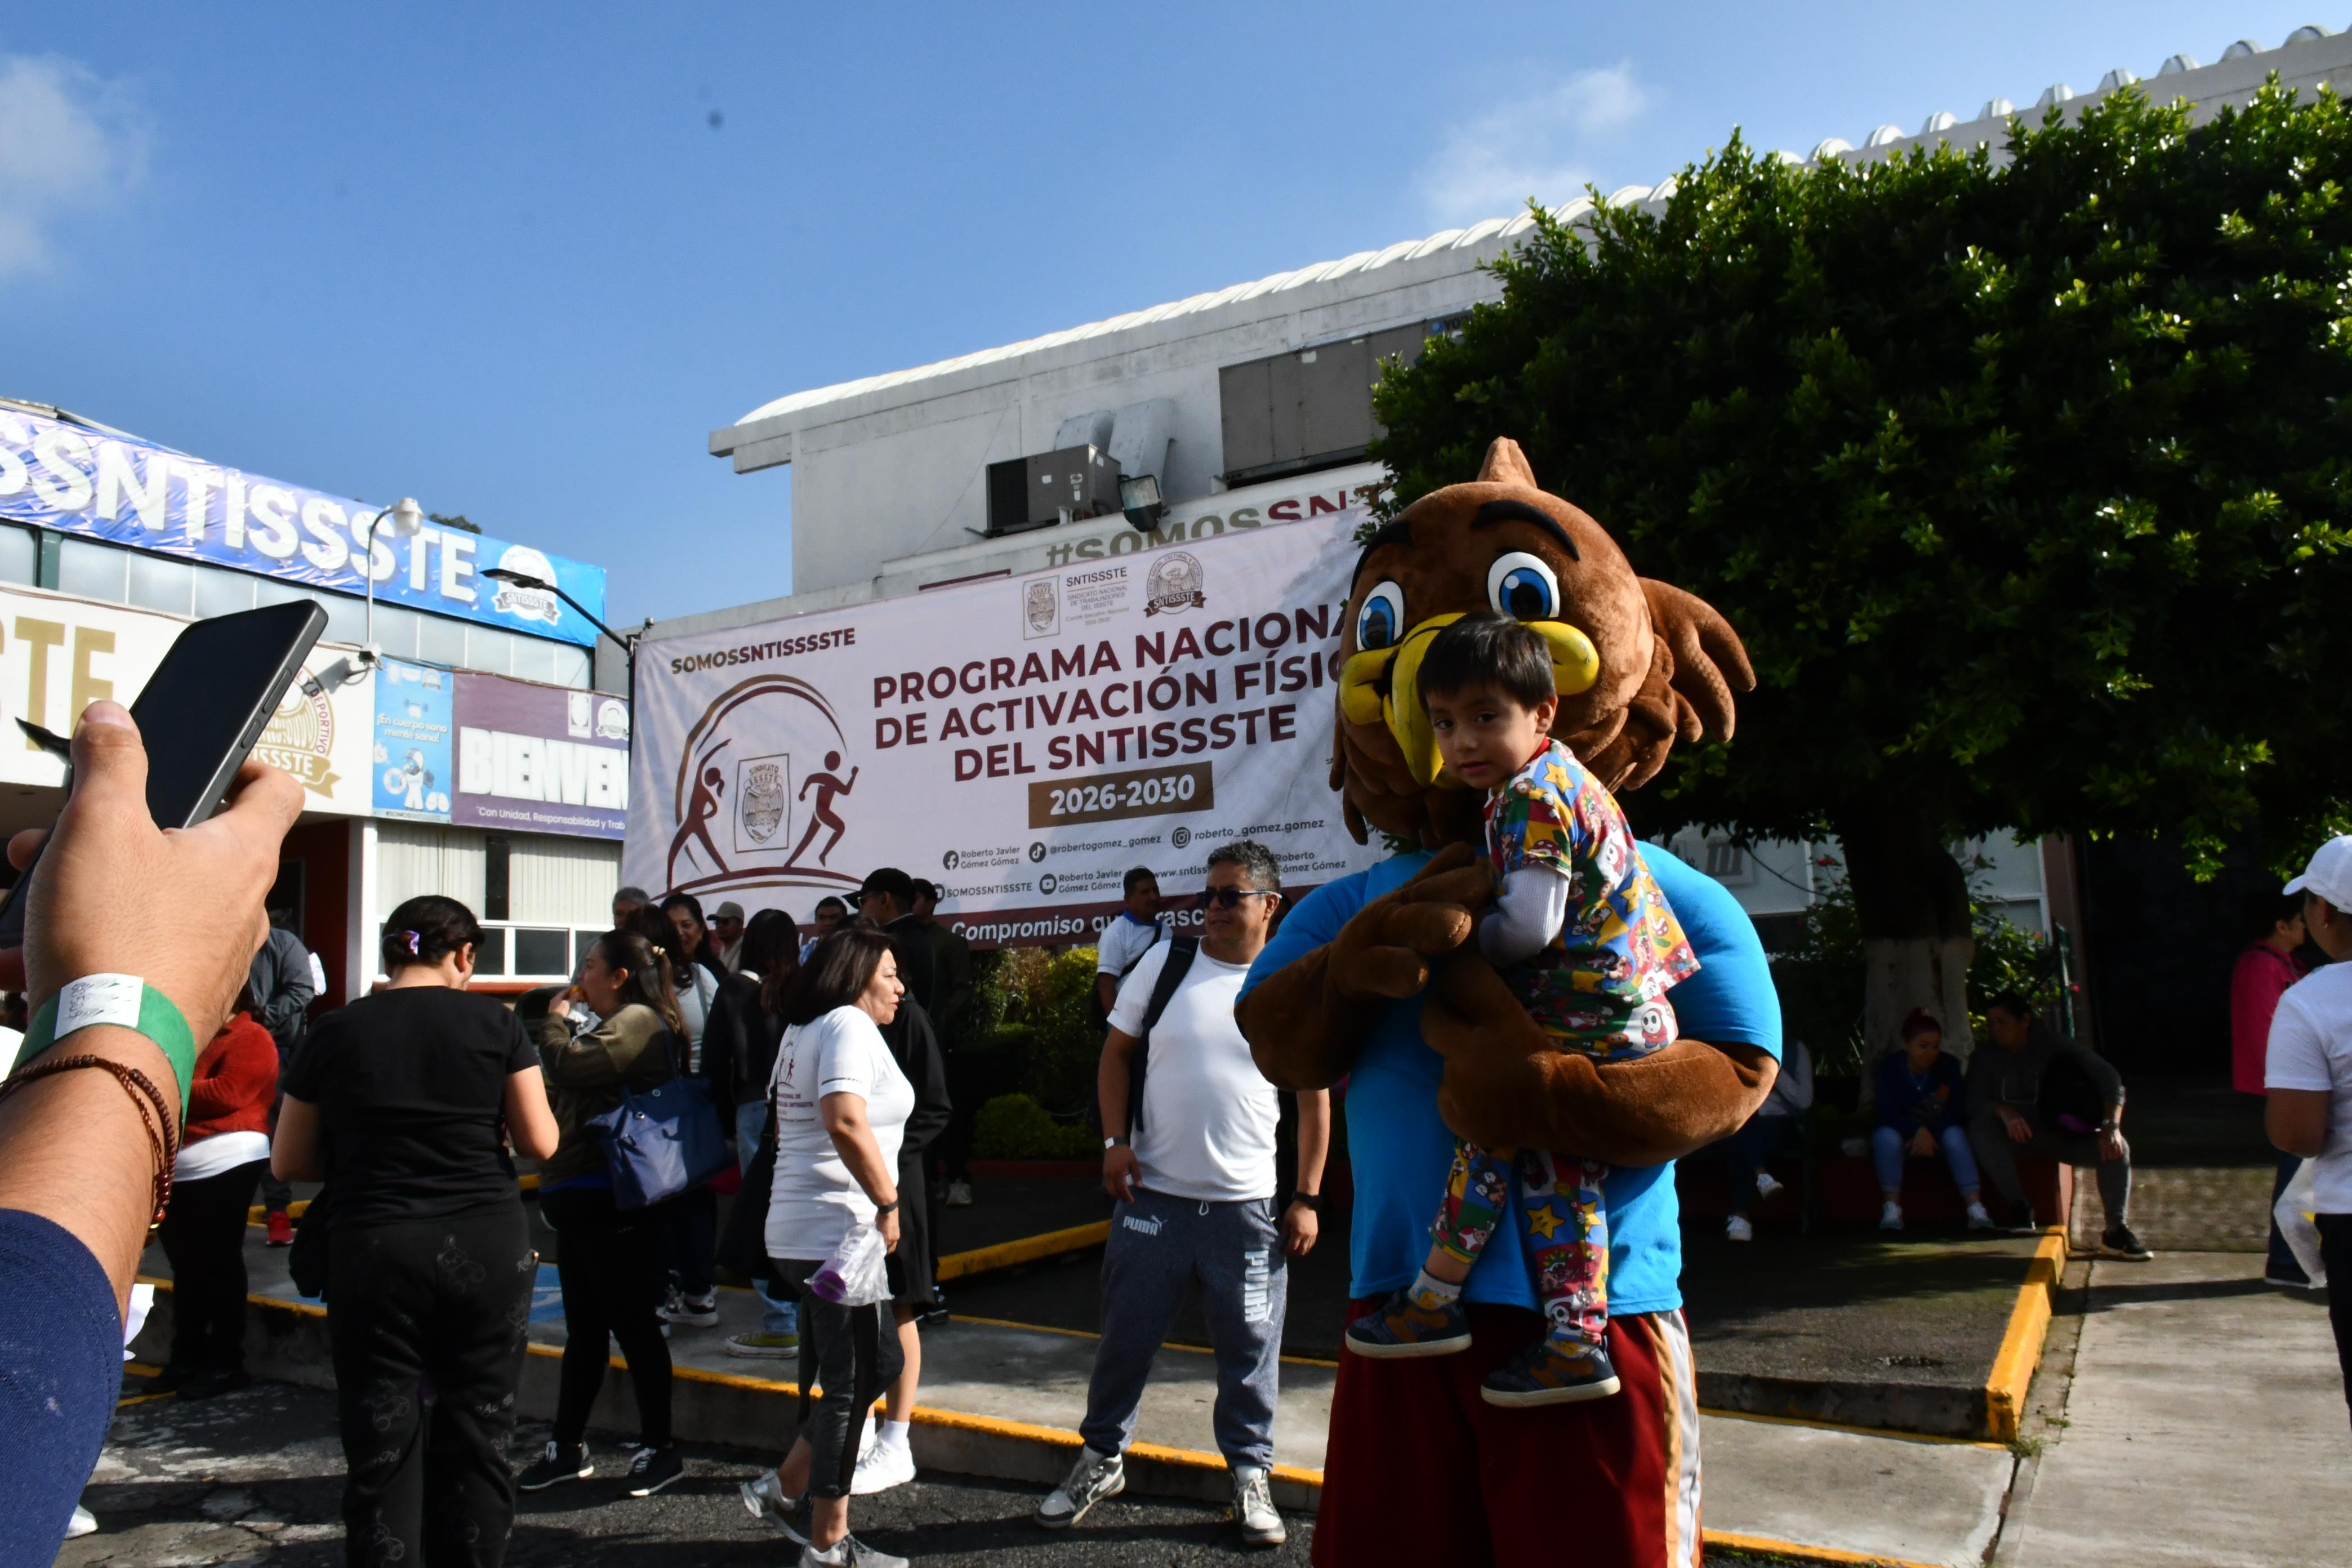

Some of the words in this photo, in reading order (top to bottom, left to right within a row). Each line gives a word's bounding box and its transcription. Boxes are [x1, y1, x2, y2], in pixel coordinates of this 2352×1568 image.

[1066, 567, 1127, 587] SNTISSSTE
[1067, 590, 1098, 600] SINDICATO
[1099, 585, 1128, 595] NACIONAL
[1080, 592, 1125, 604] TRABAJADORES
[1153, 592, 1195, 608] SNTISSSTE
[506, 593, 549, 612] SNTISSSTE
[1094, 600, 1113, 609] ISSSTE
[671, 627, 856, 675] SOMOSSNTISSSSTE
[0, 615, 115, 751] TE
[874, 640, 1121, 708] PROGRAMA
[876, 712, 928, 750] DE
[939, 666, 1218, 741] ACTIVACIÓN
[1234, 649, 1339, 701] FÍSI
[310, 688, 329, 754] DEPORTIVO
[393, 719, 425, 730] cuerpo
[426, 724, 448, 733] sano
[385, 729, 414, 739] mente
[955, 742, 1035, 782] DEL
[1048, 703, 1297, 770] SNTISSSTE
[253, 749, 314, 776] ISSSTE
[459, 726, 629, 810] BIENVEN
[749, 764, 779, 776] SINDICATO
[750, 774, 778, 785] ISSSTE
[1050, 774, 1195, 816] 2026-2030
[500, 809, 531, 821] Unidad,
[533, 813, 600, 827] Responsabilidad
[601, 821, 607, 830] y
[608, 820, 626, 830] Trab
[1195, 819, 1324, 841] roberto_gomez.gomez
[961, 849, 994, 858] Roberto
[996, 846, 1020, 855] Javier
[1050, 836, 1161, 854] @robertogomez_gomez
[961, 860, 988, 868] Gómez
[991, 857, 1019, 866] Gómez
[1280, 864, 1309, 873] ómez
[1312, 861, 1346, 870] Gómez
[1059, 872, 1093, 882] Roberto
[1096, 870, 1122, 879] Javier
[1155, 866, 1209, 878] www.sntiss
[947, 883, 1032, 898] SOMOSSNTISSSTE
[1058, 884, 1089, 893] Gómez
[1091, 881, 1121, 890] Gómez
[951, 915, 1084, 943] Compromiso
[1123, 1215, 1158, 1236] PUMA
[1245, 1250, 1268, 1322] PUMA
